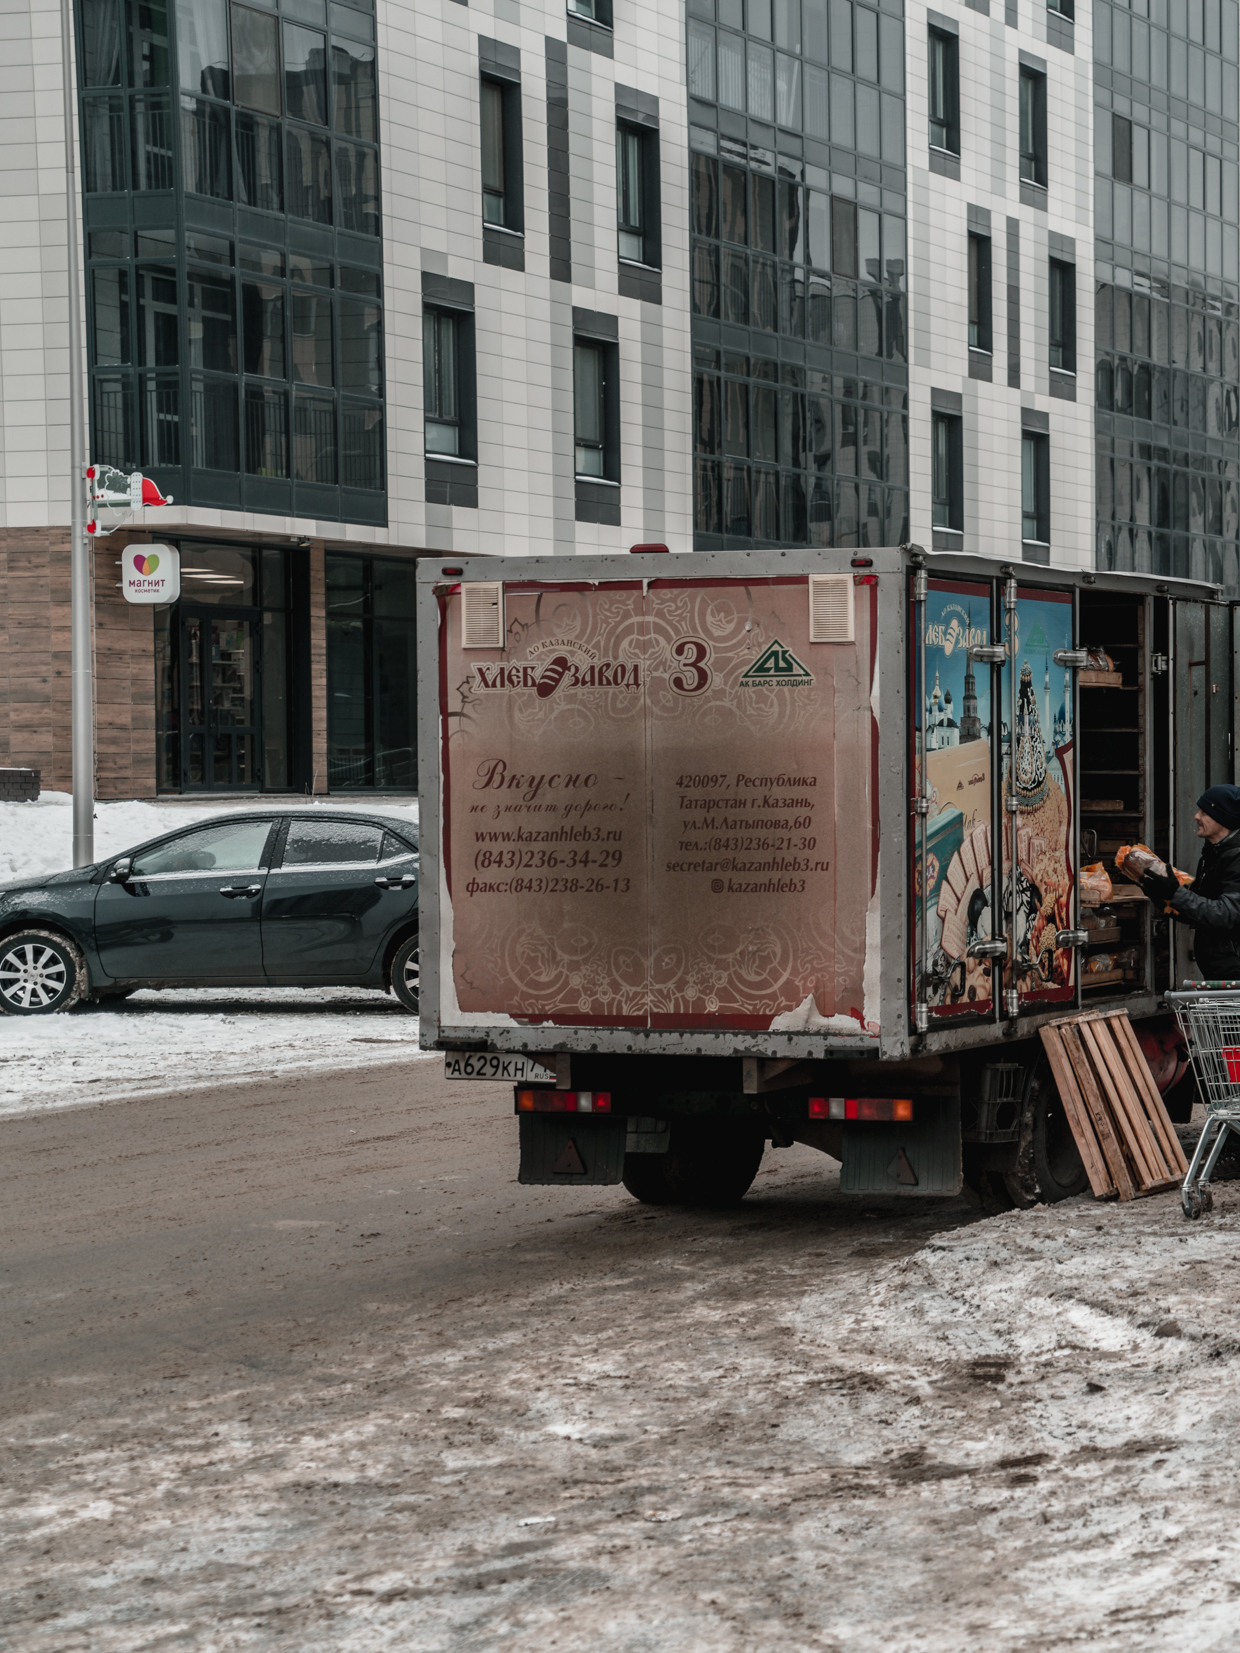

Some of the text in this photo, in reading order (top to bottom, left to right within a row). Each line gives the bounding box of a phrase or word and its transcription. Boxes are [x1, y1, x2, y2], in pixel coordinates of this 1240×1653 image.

[528, 638, 598, 661] АО КАЗАНСКИЙ
[669, 637, 712, 696] 3
[739, 678, 814, 688] АК БАРС ХОЛДИНГ
[472, 758, 599, 802] Вкусно
[676, 773, 817, 791] 420097, Республика
[469, 793, 631, 819] не значит дорого!
[679, 795, 815, 813] Татарстан г.Казань,
[682, 815, 812, 834] ул.М.Латыпова,60
[474, 826, 623, 843] www.kazanhleb3.ru
[678, 836, 817, 853] тел.:(843)236-21-30
[474, 849, 623, 871] (843)236-34-29
[665, 857, 830, 872] secretar@kazanhleb3.ru
[466, 877, 631, 897] факс:(843)238-26-13
[727, 878, 807, 894] kazanhleb3
[451, 1054, 525, 1078] А629КН
[534, 1072, 549, 1080] RUS
